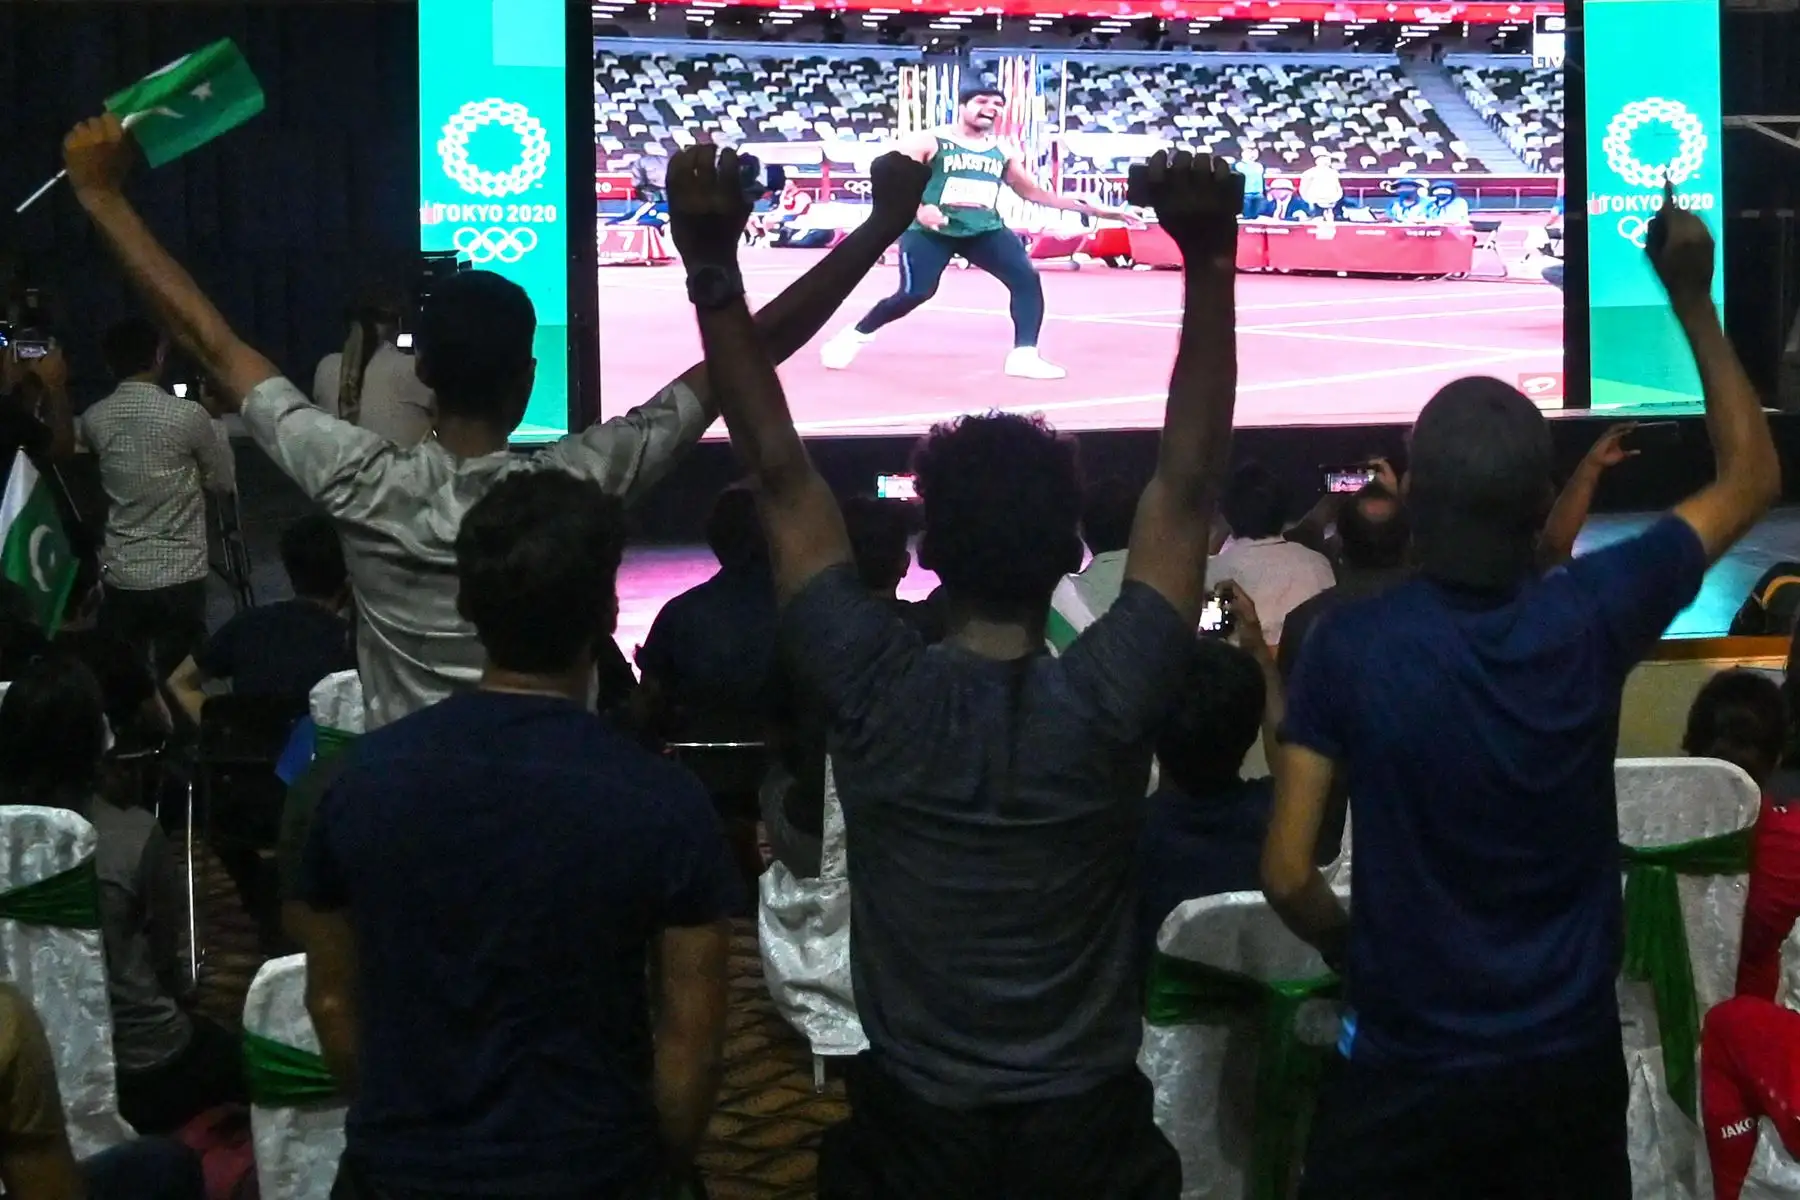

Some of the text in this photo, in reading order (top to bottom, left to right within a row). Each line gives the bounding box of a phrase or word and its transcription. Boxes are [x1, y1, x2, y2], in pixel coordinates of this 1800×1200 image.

[433, 203, 557, 223] TOKYO 2020
[1599, 193, 1714, 213] TOKYO 020
[1721, 1117, 1754, 1139] JAKO
